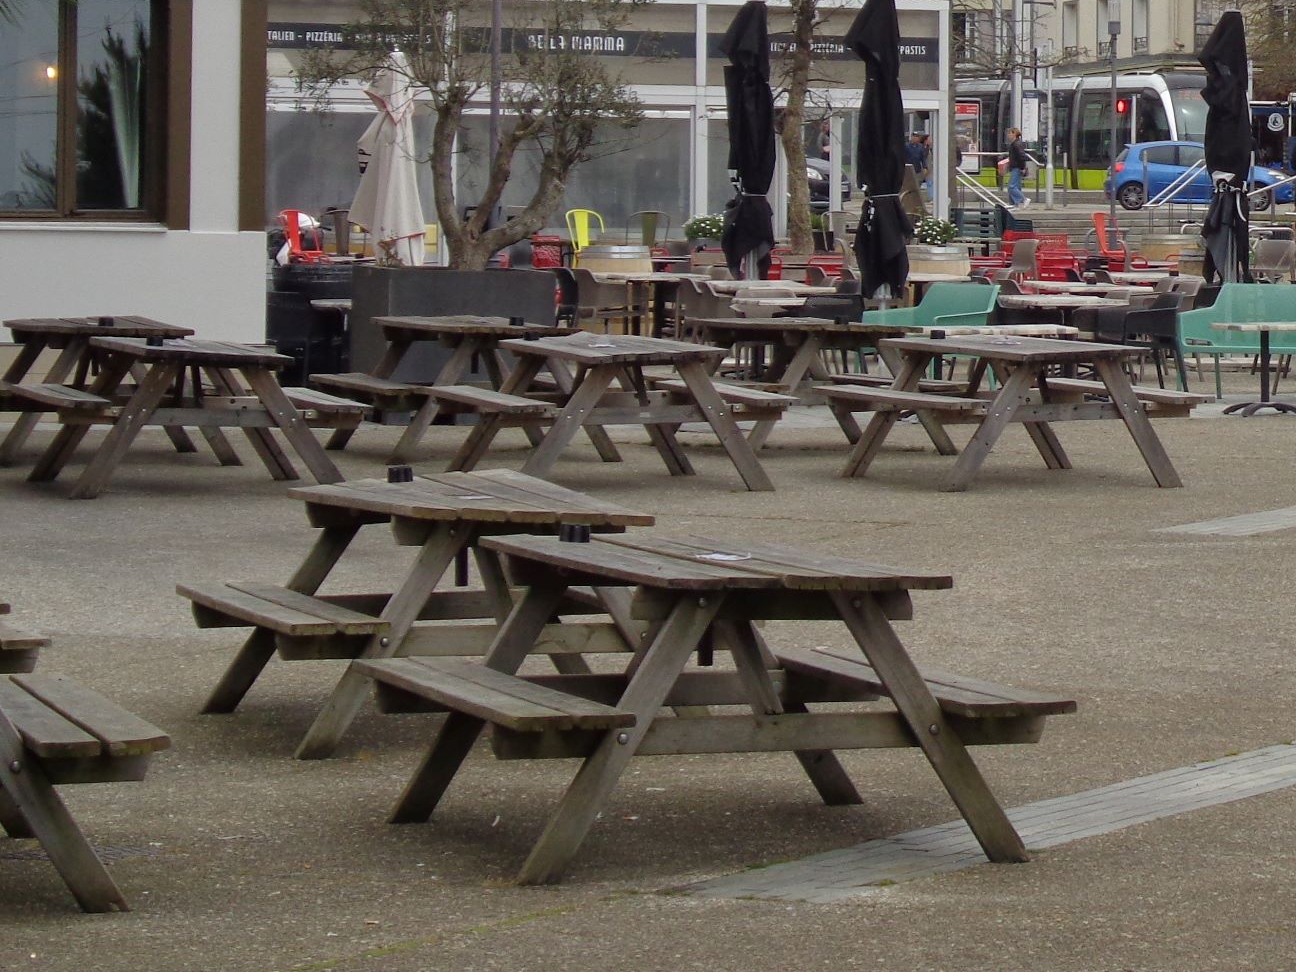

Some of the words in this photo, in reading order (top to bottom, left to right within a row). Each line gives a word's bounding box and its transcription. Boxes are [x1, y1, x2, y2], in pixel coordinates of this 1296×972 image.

[267, 30, 295, 41] TALIEN
[528, 34, 565, 49] BELA
[571, 36, 625, 51] MAMMA
[897, 45, 926, 55] PASTIS
